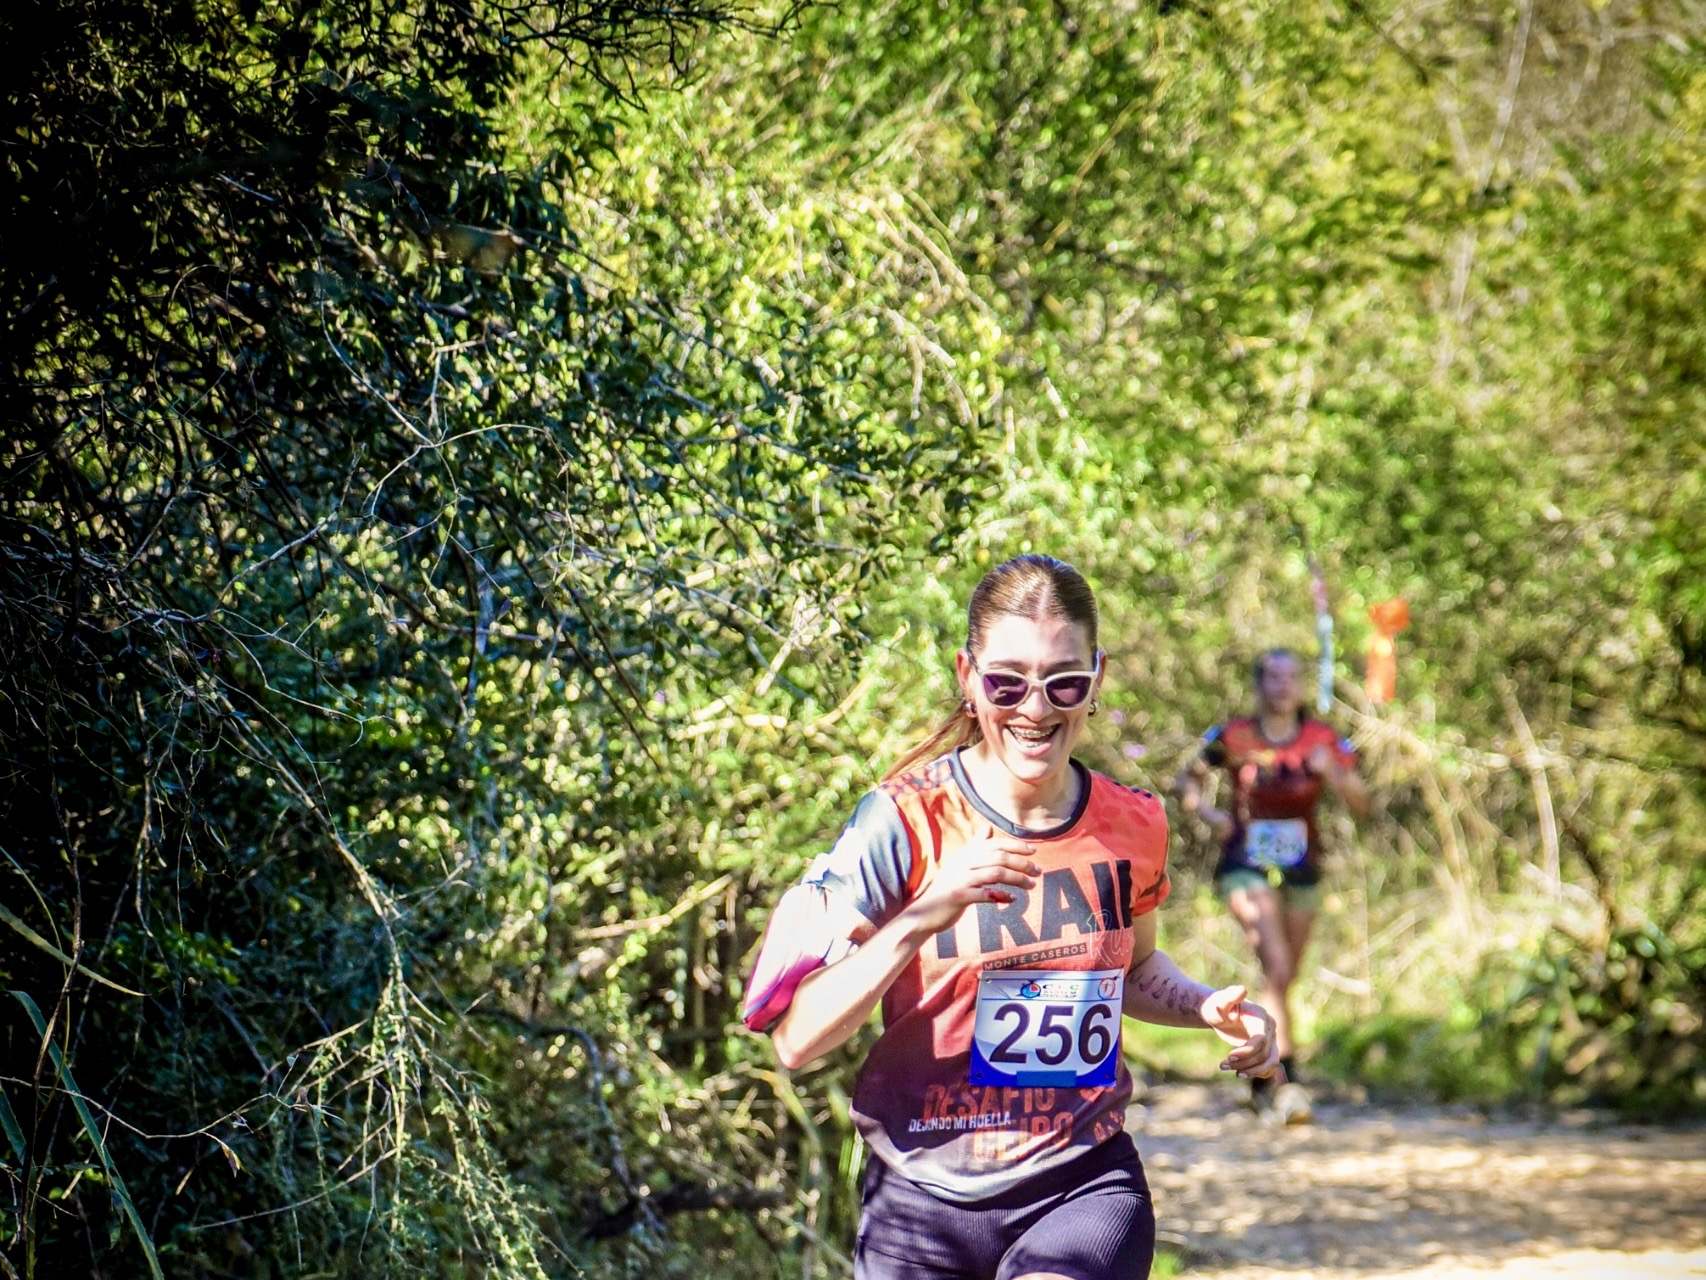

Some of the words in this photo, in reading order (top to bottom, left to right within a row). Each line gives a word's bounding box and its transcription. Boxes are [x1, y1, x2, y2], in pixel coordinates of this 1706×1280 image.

[983, 954, 1027, 970] MONTE
[1031, 944, 1087, 961] CASEROS
[989, 1002, 1112, 1065] 256
[908, 1116, 951, 1133] DEJANDO
[953, 1116, 967, 1130] MI
[969, 1111, 1012, 1129] HUELLA
